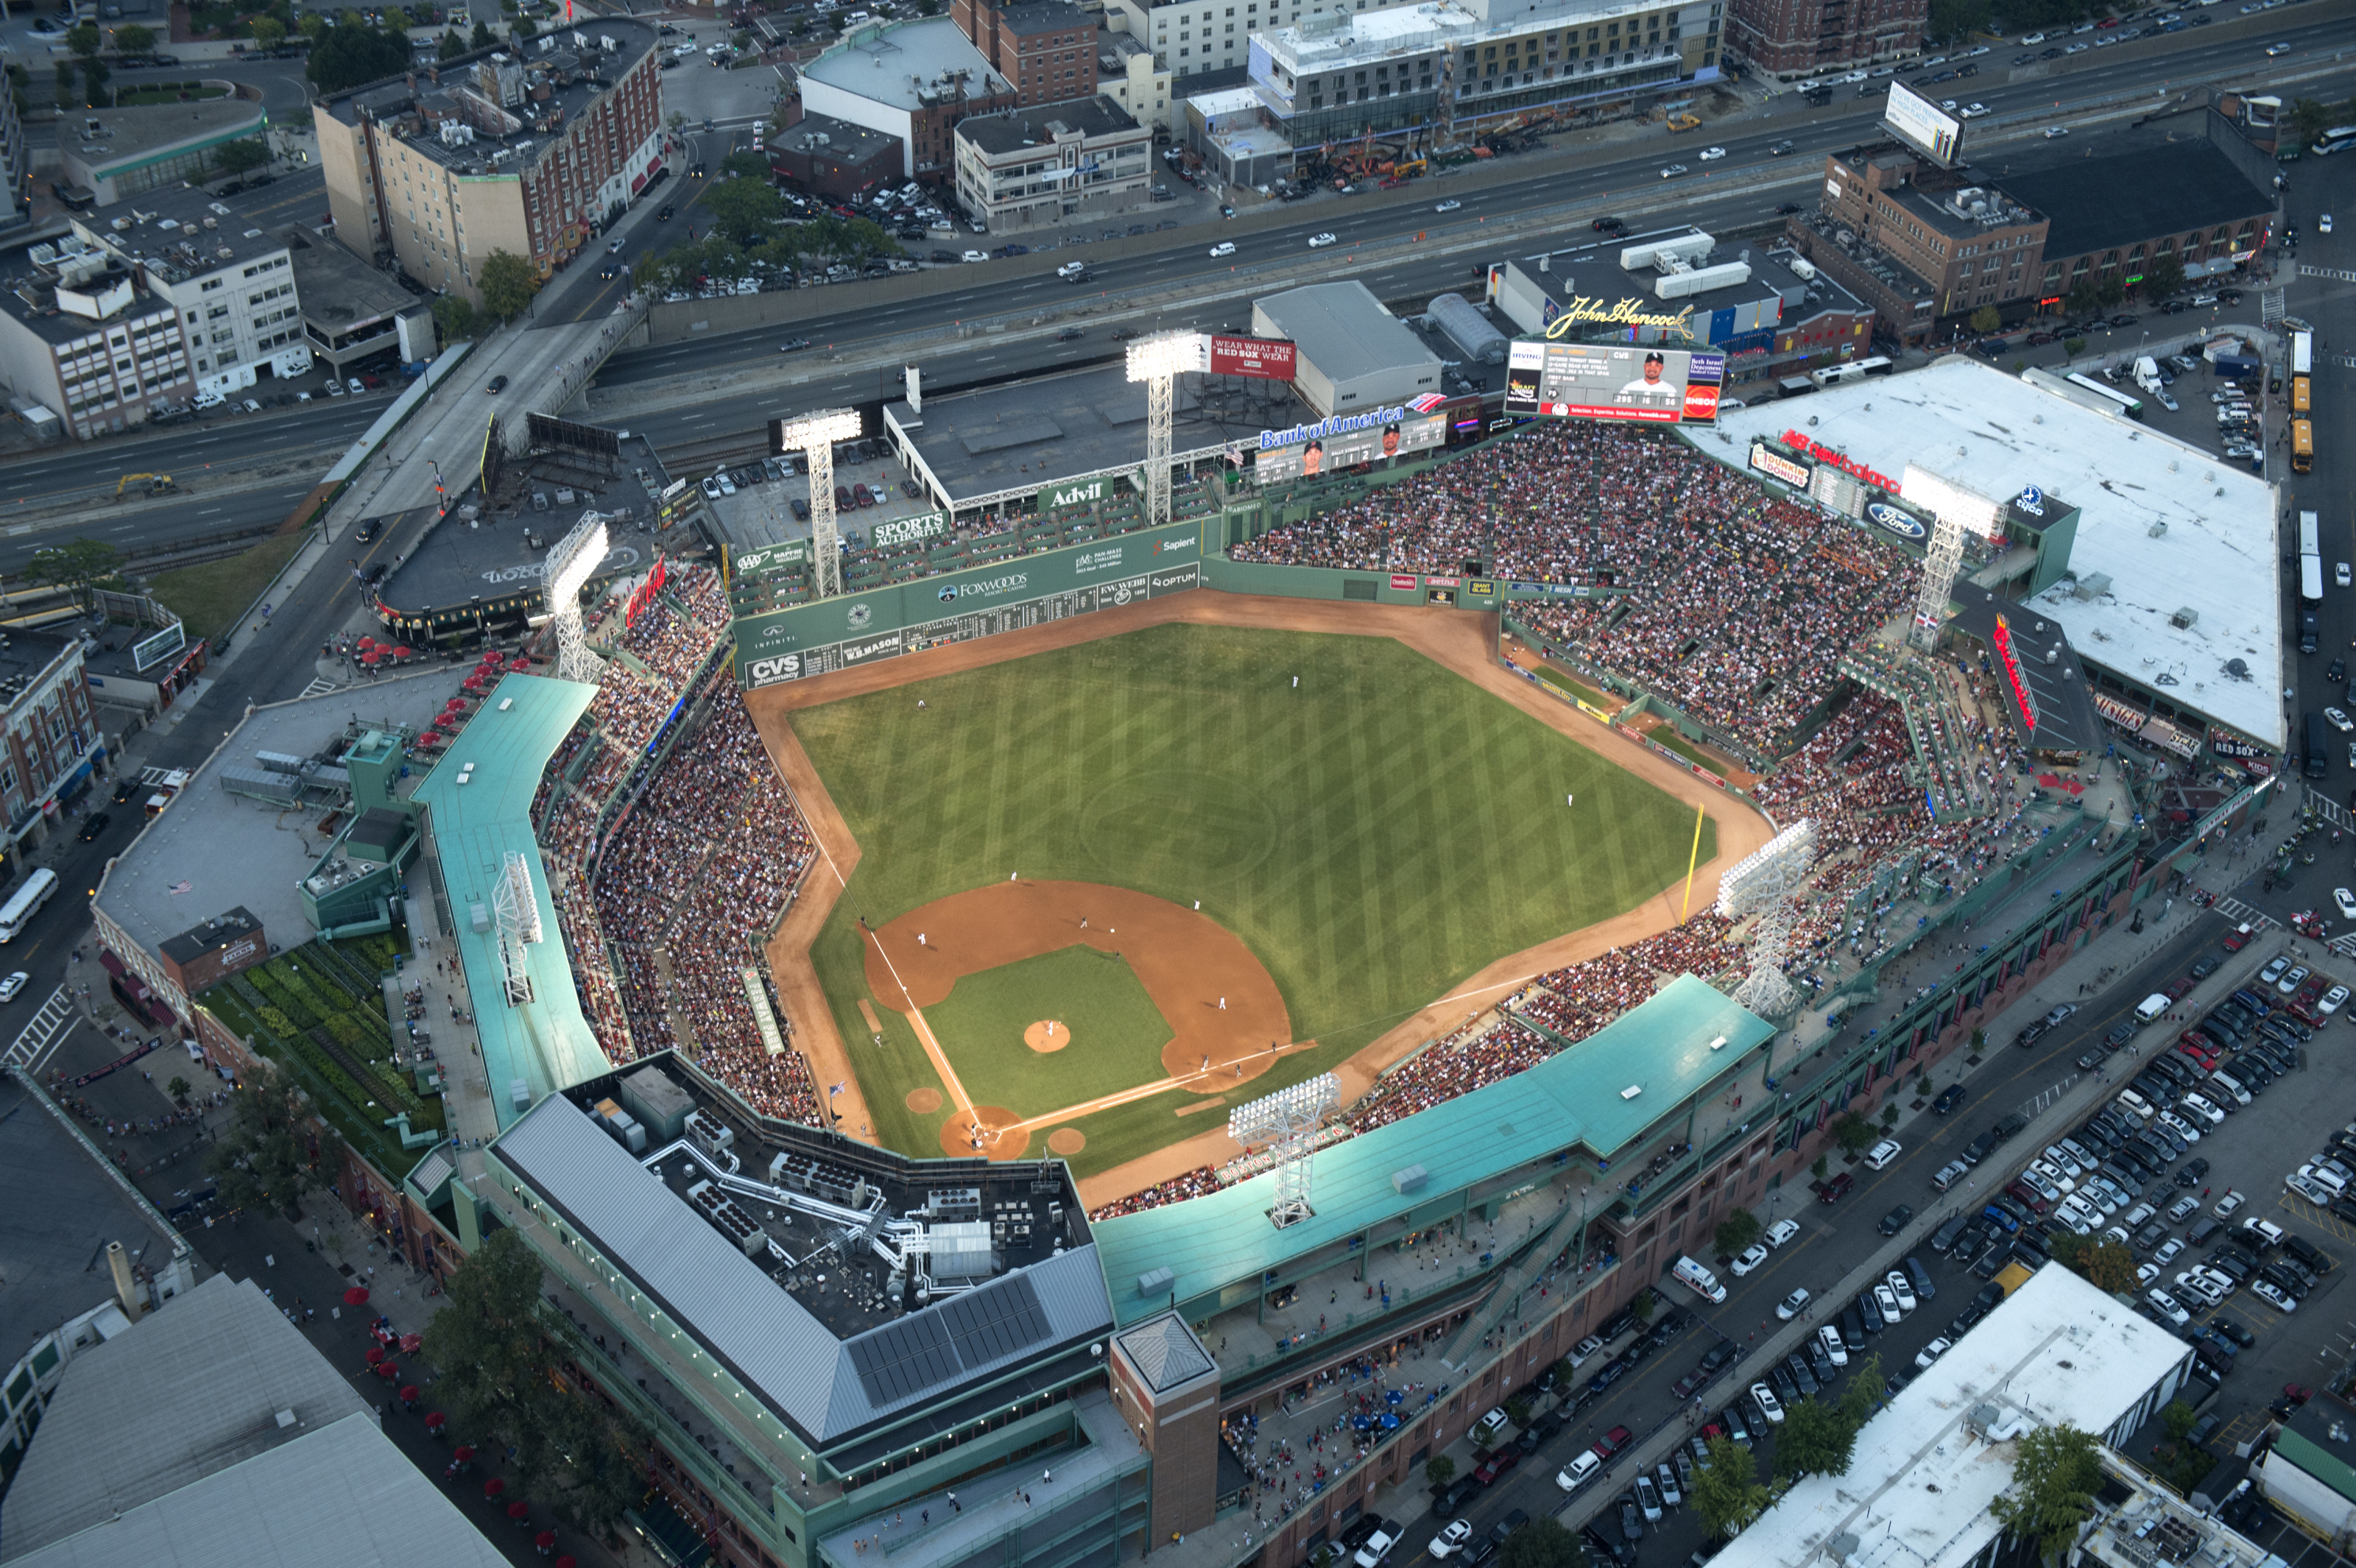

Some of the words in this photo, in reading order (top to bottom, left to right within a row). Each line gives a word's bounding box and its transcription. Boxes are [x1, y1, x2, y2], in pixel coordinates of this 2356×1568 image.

[1922, 106, 1942, 125] FRIENDS
[1547, 294, 1607, 339] John
[1606, 297, 1694, 340] Hancock
[1216, 339, 1242, 350] WEAR
[1244, 343, 1271, 353] WHAT
[1274, 346, 1291, 355] THE
[1567, 348, 1587, 356] ABREU
[1217, 348, 1238, 357] RED
[1238, 350, 1258, 359] SOX
[1262, 352, 1289, 362] WEAR
[1691, 363, 1721, 371] Deaconess
[1685, 397, 1716, 406] ENEOS
[1260, 423, 1307, 449] Bank
[1308, 417, 1328, 439] of
[1329, 405, 1404, 435] America
[1257, 448, 1286, 459] PORCELLO
[1363, 451, 1369, 460] 2
[1257, 458, 1275, 466] TONIGHT
[1768, 453, 1809, 477] DUNKIN'
[1809, 442, 1841, 467] new
[1841, 454, 1902, 496] balanc
[1767, 463, 1805, 486] DONUTS
[672, 488, 696, 507] BIGELOW
[1050, 482, 1103, 508] Advil
[1232, 502, 1261, 514] ABIOMED
[2016, 498, 2044, 516] tyco
[875, 512, 944, 539] SPORTS
[1879, 509, 1914, 535] Ford
[1163, 537, 1196, 551] Sapient
[774, 548, 803, 559] MAPFRE
[776, 554, 803, 564] INSURANCE
[1094, 548, 1122, 558] PAN-MASS
[1094, 553, 1122, 563] CHALLENGE
[739, 555, 760, 569] AAA
[960, 572, 1027, 597] FOXWOODS
[1120, 578, 1146, 590] WEBB
[1163, 572, 1196, 587] OPTUM
[1431, 578, 1455, 586] aetna
[984, 589, 1003, 597] RESORT
[1006, 584, 1026, 593] CASINO
[755, 635, 796, 649] INFINITI
[752, 654, 800, 679] CVS
[1513, 664, 1528, 677] jetBlue
[754, 671, 799, 688] pharmacy
[1585, 705, 1602, 719] Nikon
[2094, 694, 2144, 730] SAUSAGES
[1621, 726, 1640, 740] xfinity
[2215, 730, 2229, 743] GO
[2170, 733, 2198, 752] STEAK
[2216, 742, 2234, 754] RED
[2236, 746, 2254, 757] SOX
[1664, 749, 1672, 757] ACE
[1672, 752, 1686, 764] TICKET
[2167, 743, 2192, 757] CHEESE
[2249, 761, 2269, 774] KIDS
[749, 982, 772, 1023] FENWAY
[763, 1023, 782, 1052] PARK
[1220, 1154, 1272, 1181] BOSTON
[1302, 1131, 1330, 1148] SOX
